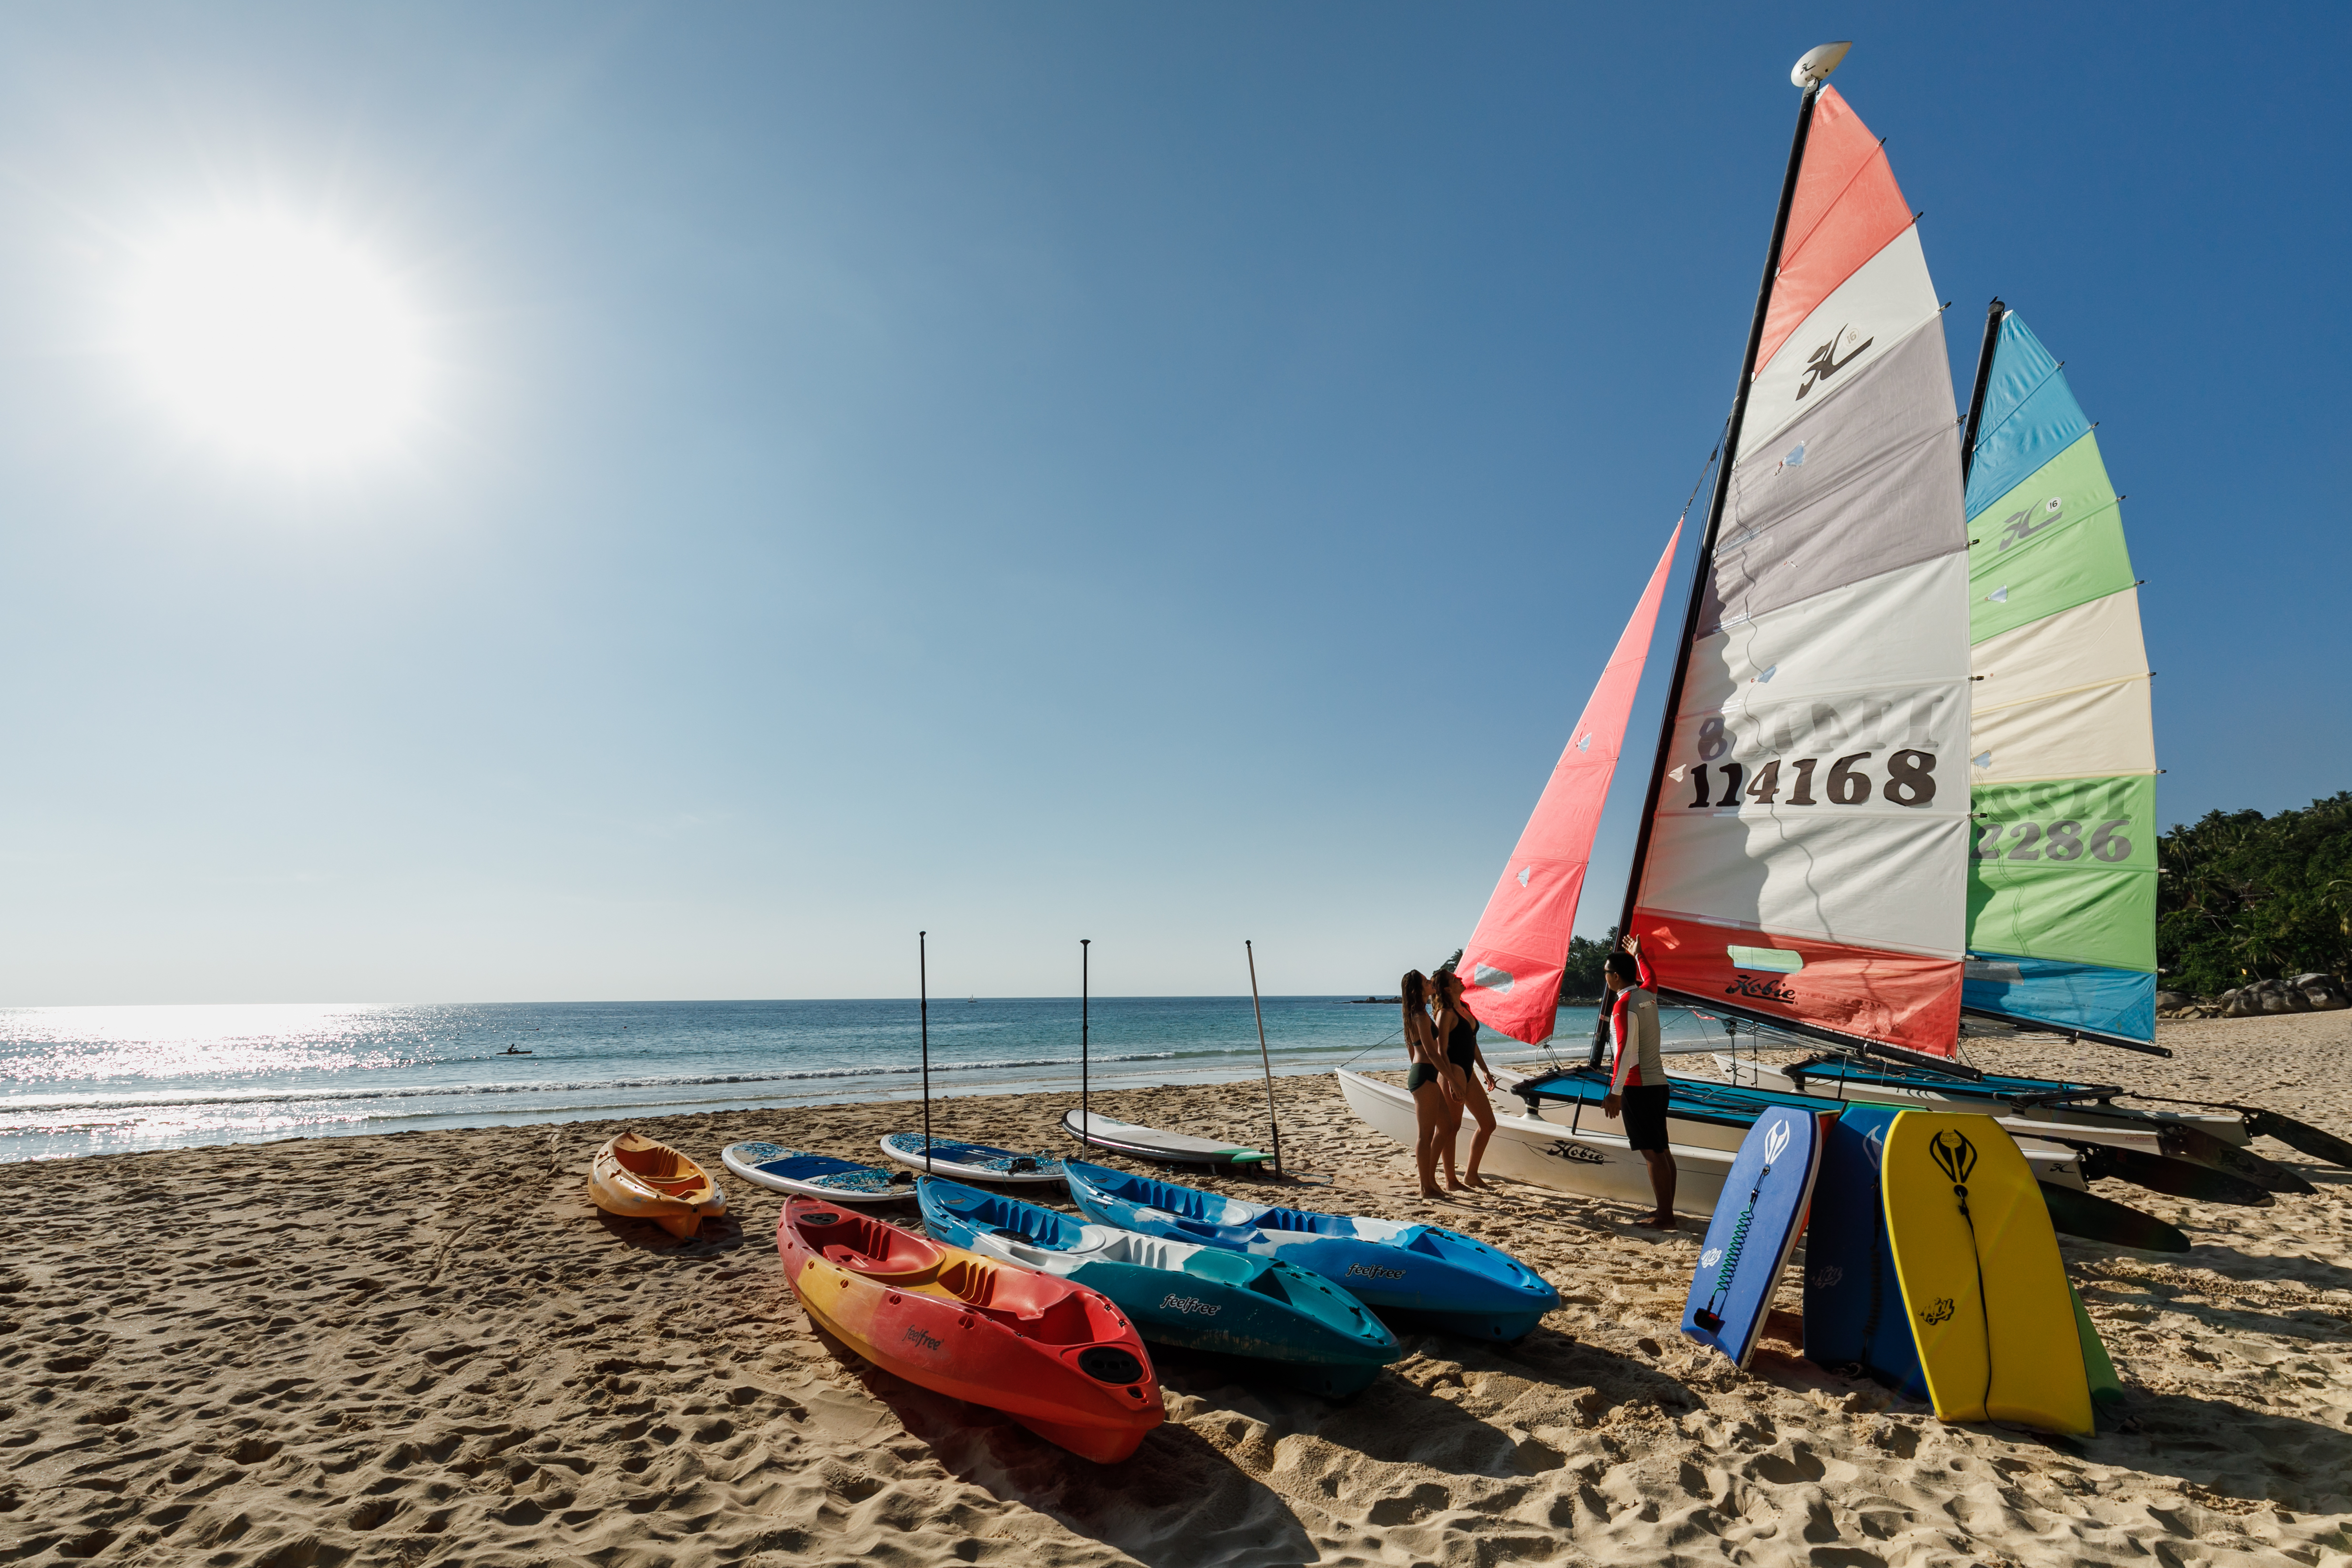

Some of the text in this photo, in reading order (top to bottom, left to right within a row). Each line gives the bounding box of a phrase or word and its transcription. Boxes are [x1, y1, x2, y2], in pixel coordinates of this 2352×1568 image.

[1847, 331, 1857, 344] 16
[2050, 500, 2058, 509] 16
[1688, 748, 1937, 808] 114168
[1970, 820, 2132, 862] 2286
[1725, 974, 1796, 1004] Hobie
[1547, 1140, 1604, 1165] Hobie
[1345, 1262, 1403, 1280] feelfree
[1160, 1293, 1218, 1316] feelfree
[902, 1324, 941, 1351] feelfree
